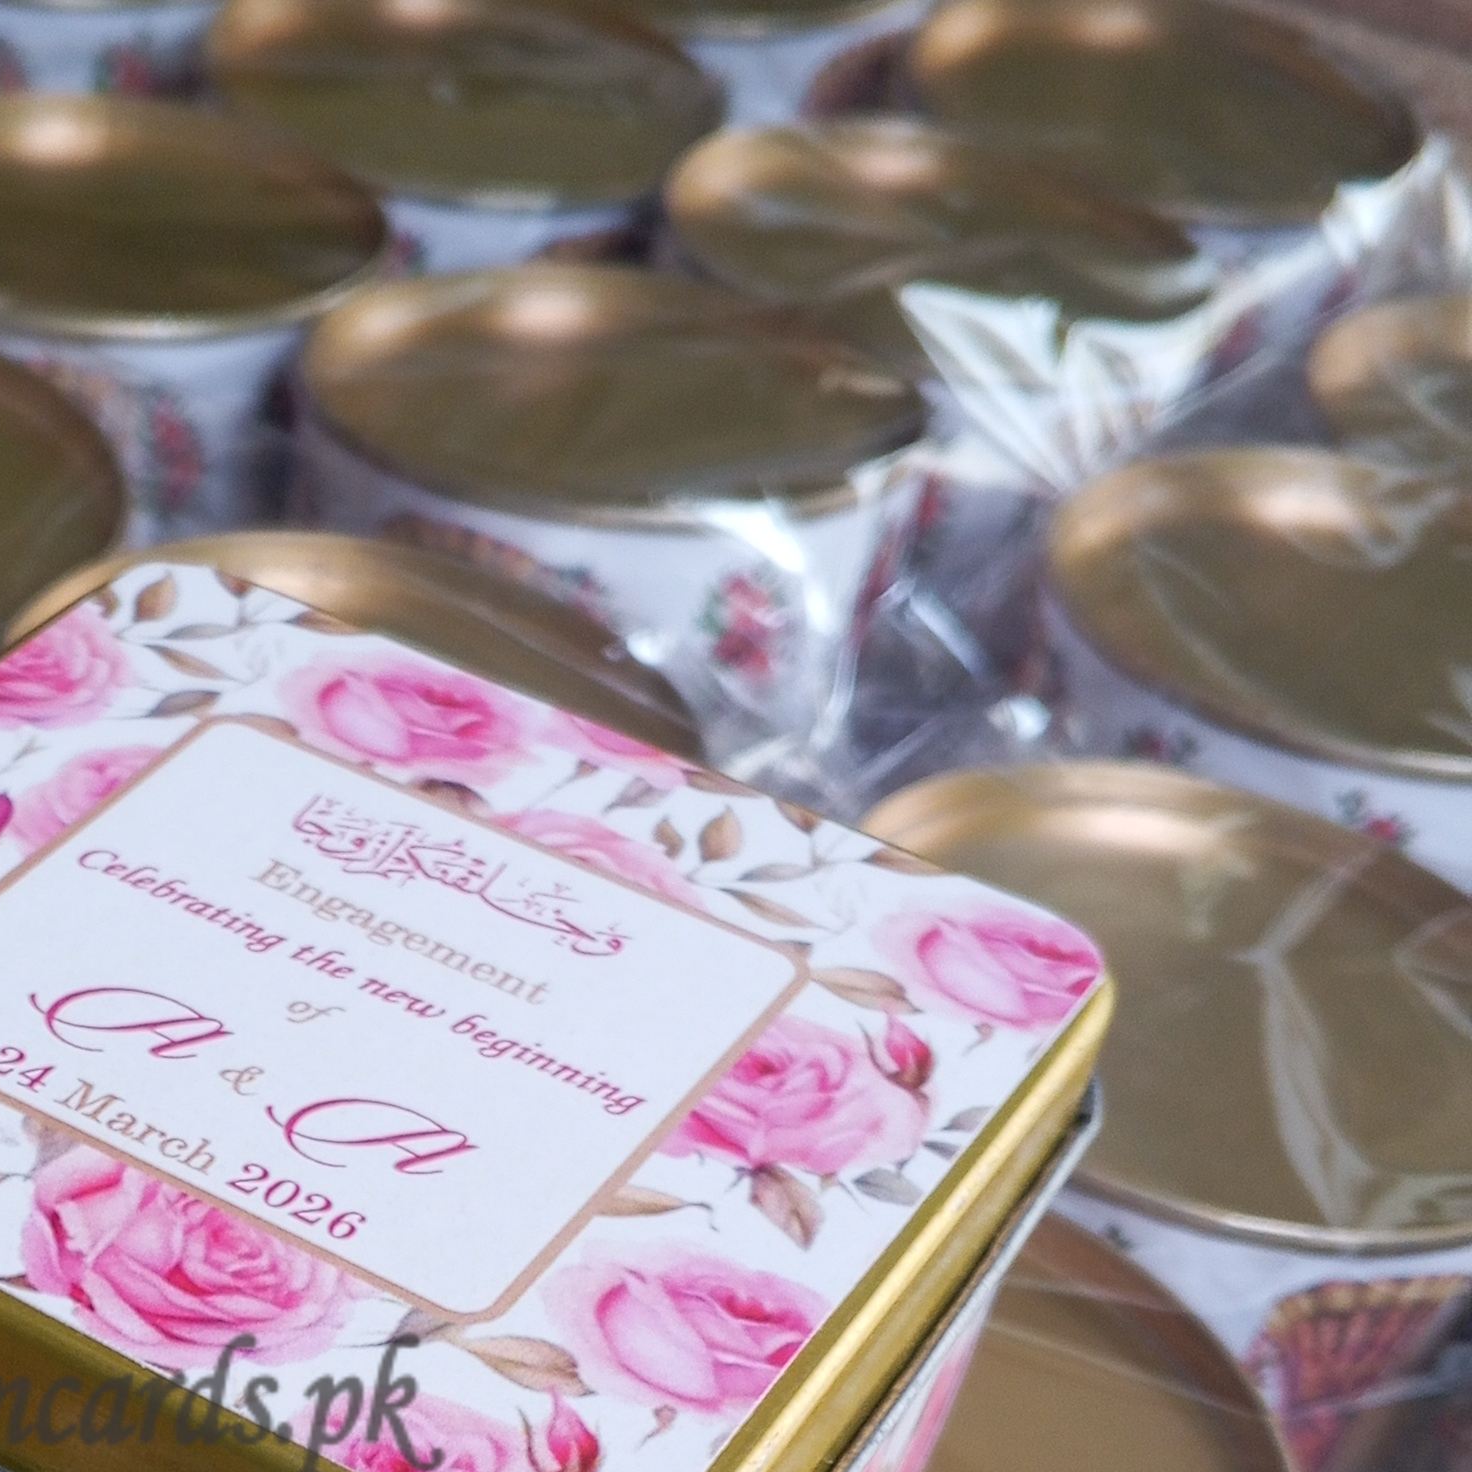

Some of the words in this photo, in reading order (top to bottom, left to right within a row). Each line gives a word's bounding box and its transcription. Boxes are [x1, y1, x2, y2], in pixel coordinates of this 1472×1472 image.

[78, 848, 285, 952] Celebrating
[290, 942, 356, 981] the
[357, 975, 448, 1020] new
[450, 1012, 648, 1116] beginning
[249, 859, 550, 1006] Engagement
[286, 996, 344, 1024] of
[30, 987, 234, 1060] A
[222, 1064, 265, 1097] &
[265, 1098, 479, 1175] A
[55, 1078, 218, 1177] March
[227, 1162, 368, 1242] 2026
